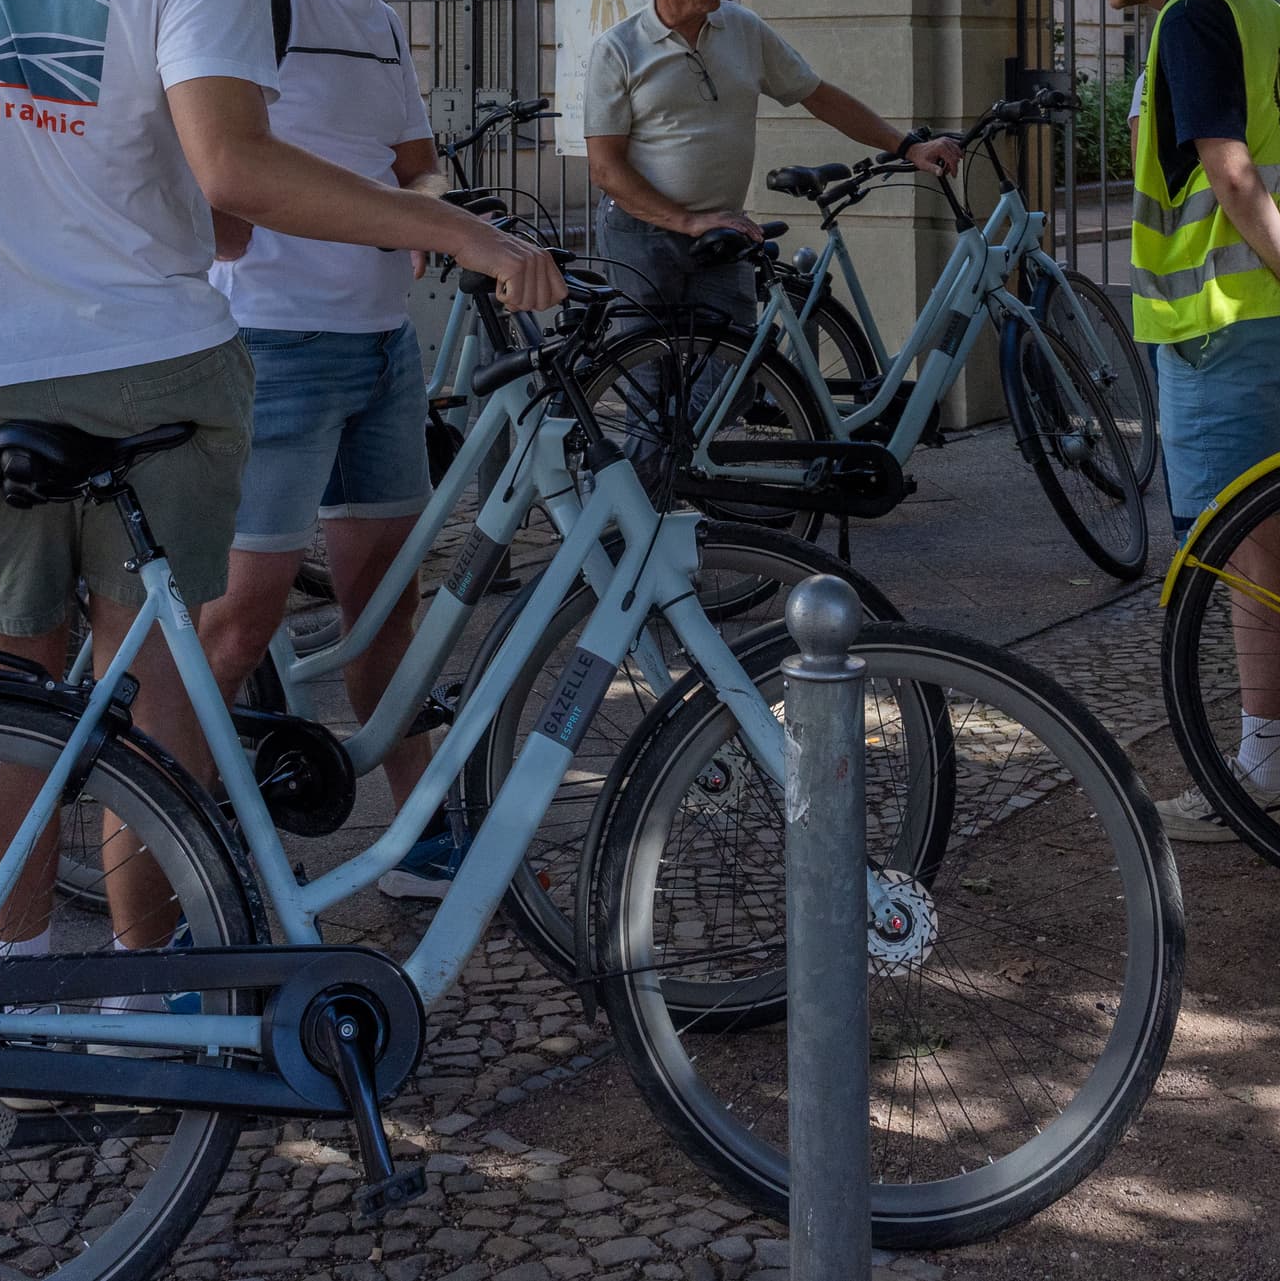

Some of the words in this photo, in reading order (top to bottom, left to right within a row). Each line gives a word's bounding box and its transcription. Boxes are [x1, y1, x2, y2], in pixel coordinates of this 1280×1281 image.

[446, 528, 484, 591] GAZELLE
[457, 571, 474, 597] ESPRIT
[543, 653, 594, 735] GAZELLE
[560, 705, 583, 742] ESPRIT
